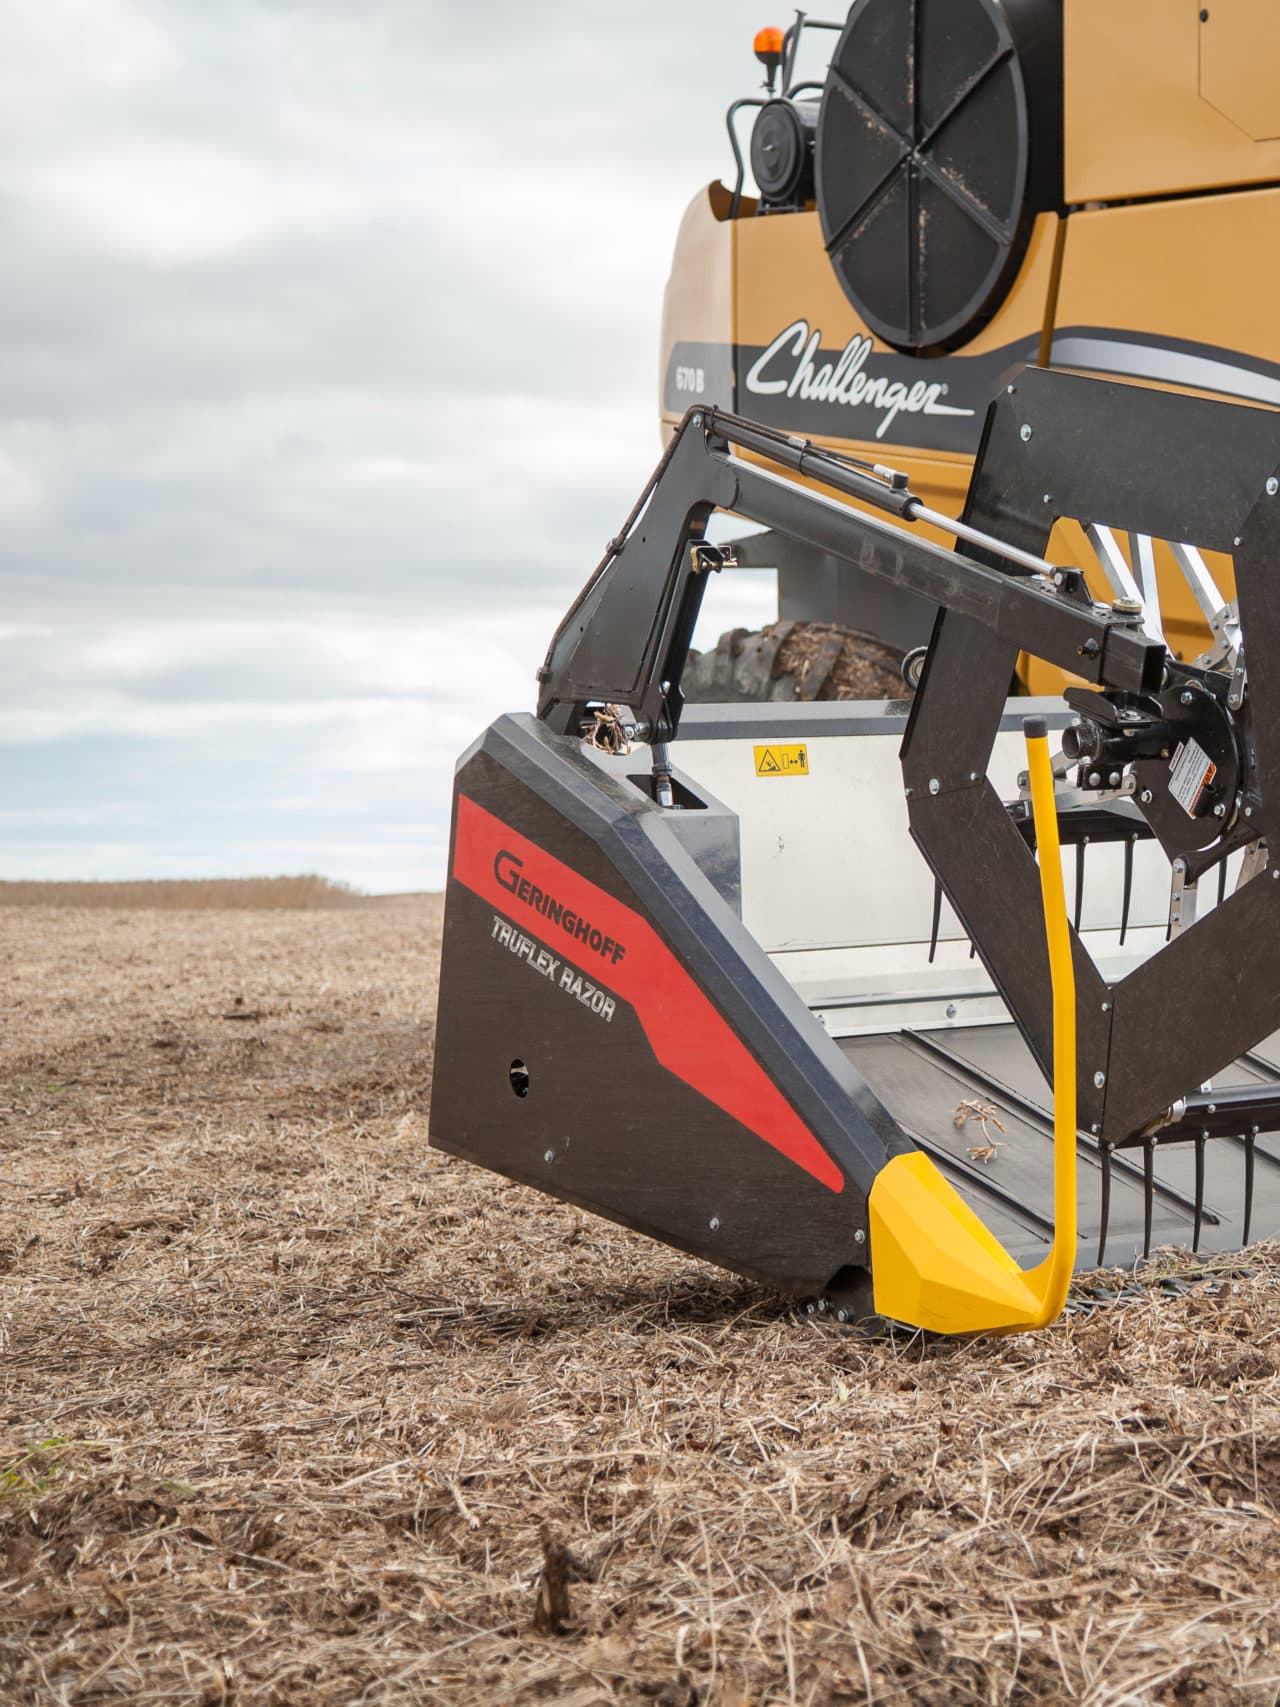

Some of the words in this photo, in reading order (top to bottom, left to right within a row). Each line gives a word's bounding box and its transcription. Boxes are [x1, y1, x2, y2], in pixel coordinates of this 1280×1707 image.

[745, 318, 976, 439] Challenger
[493, 849, 627, 965] GERINGHOFF
[490, 915, 561, 981] TRUFLEX
[558, 967, 617, 1023] RAZOR
